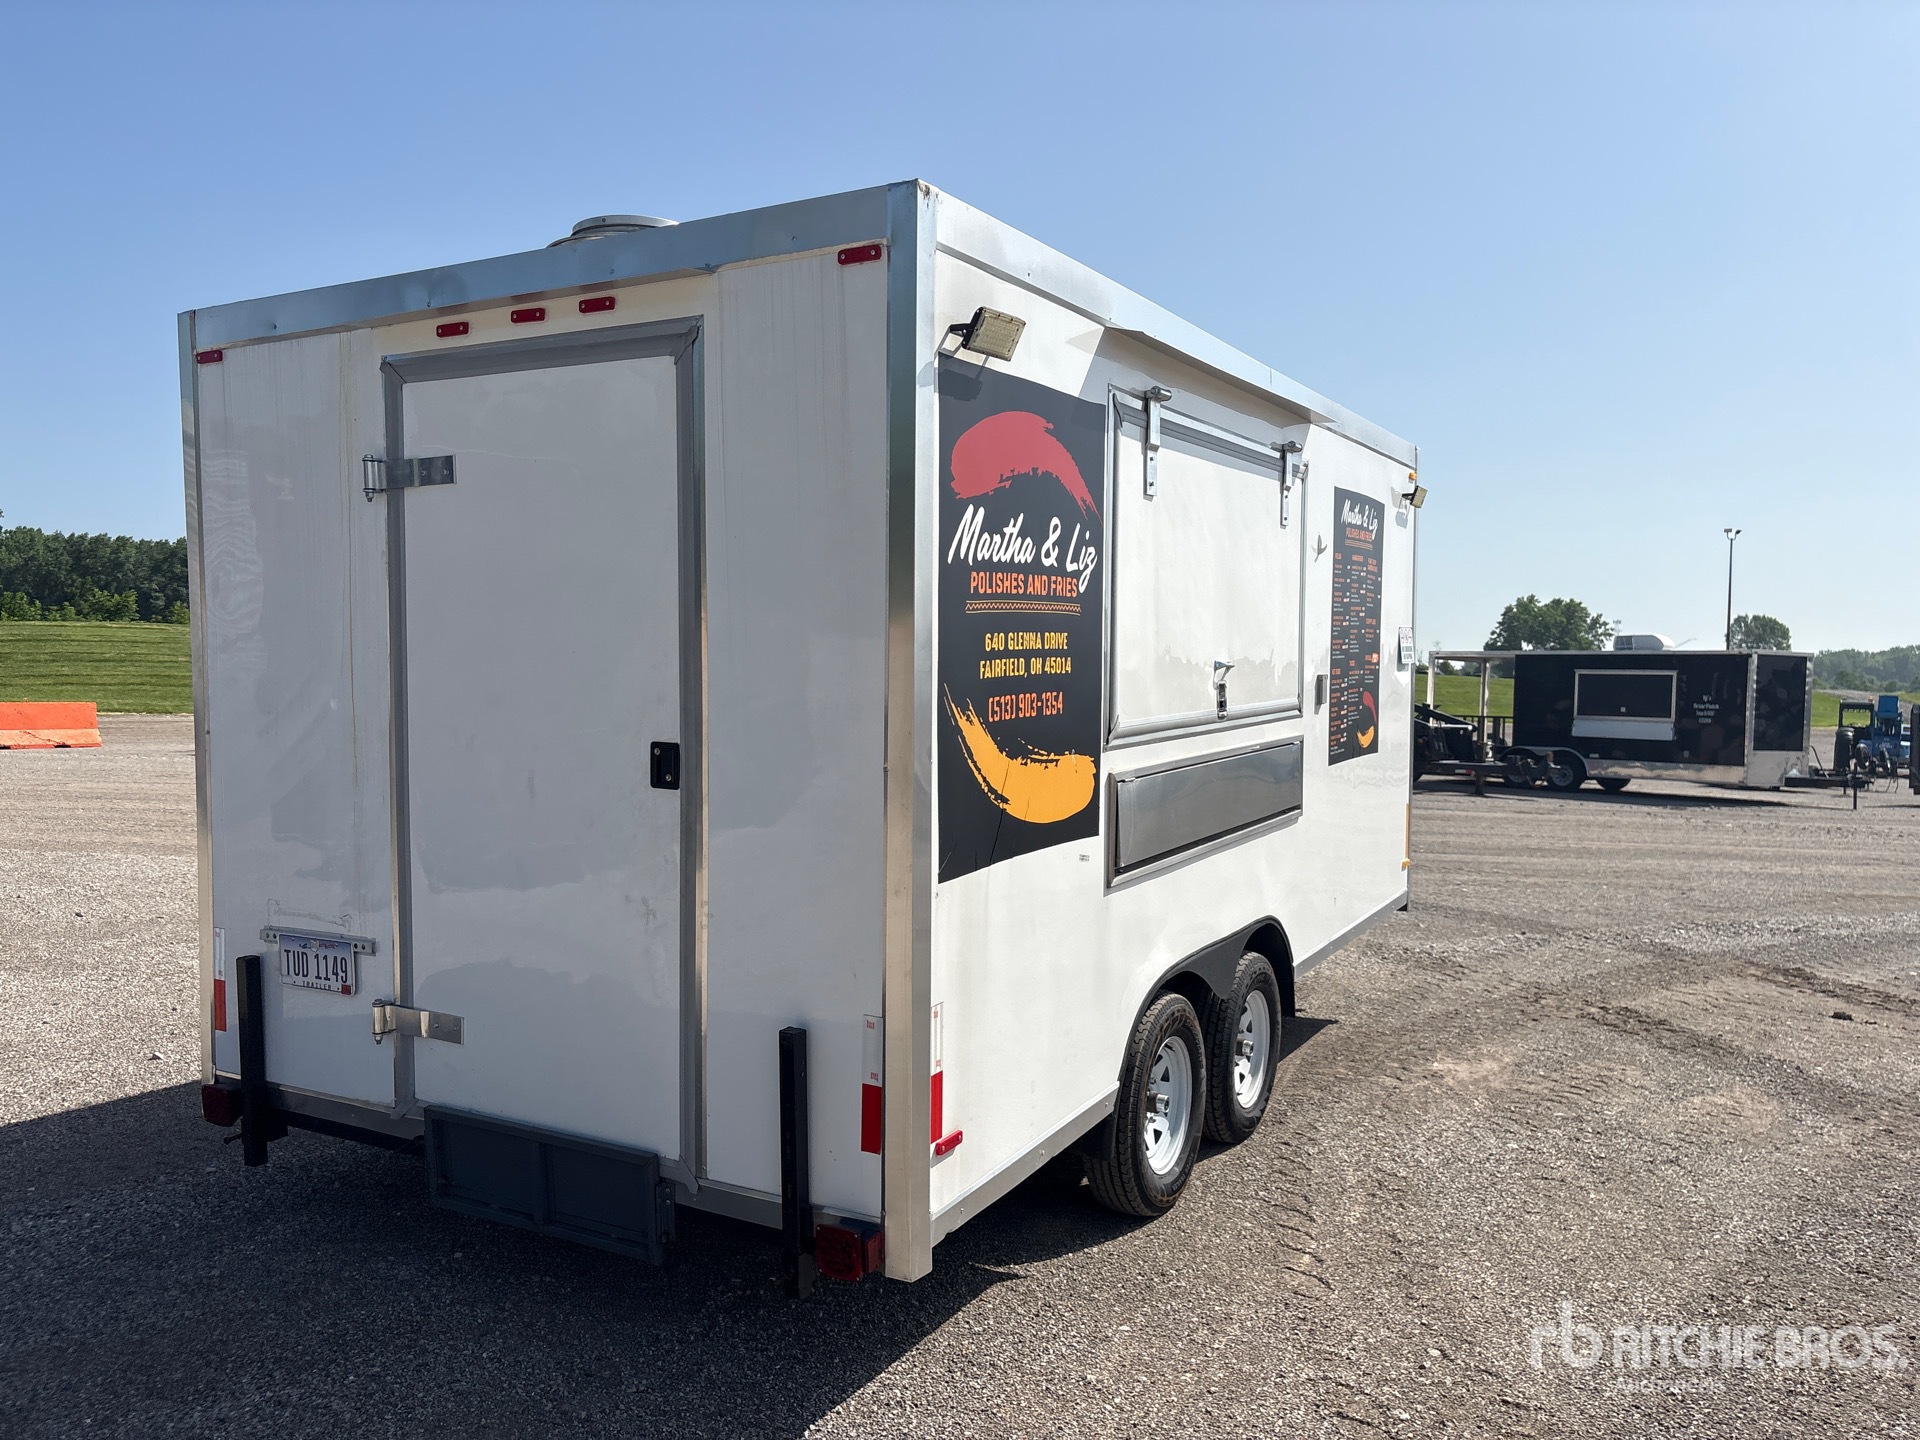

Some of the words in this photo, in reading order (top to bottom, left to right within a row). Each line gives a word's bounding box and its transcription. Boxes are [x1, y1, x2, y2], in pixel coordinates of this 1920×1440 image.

[947, 503, 1037, 566] Martha
[1040, 516, 1062, 567] &
[1066, 522, 1098, 593] Liz
[970, 571, 1024, 595] POLISHES
[1026, 574, 1047, 596] AND
[1050, 575, 1078, 598] FRIES
[985, 632, 1004, 651] 640
[1008, 632, 1042, 651] GLENNA
[1044, 632, 1068, 650] DRIVE
[979, 659, 1028, 680] FAIRFIELD,
[1030, 657, 1042, 675] OH
[1044, 656, 1072, 674] 45014
[988, 696, 1016, 722] (513)
[1018, 691, 1064, 719] 903-1354
[284, 949, 309, 978] TUD
[314, 953, 348, 984] 1149
[302, 980, 332, 991] TRAILER
